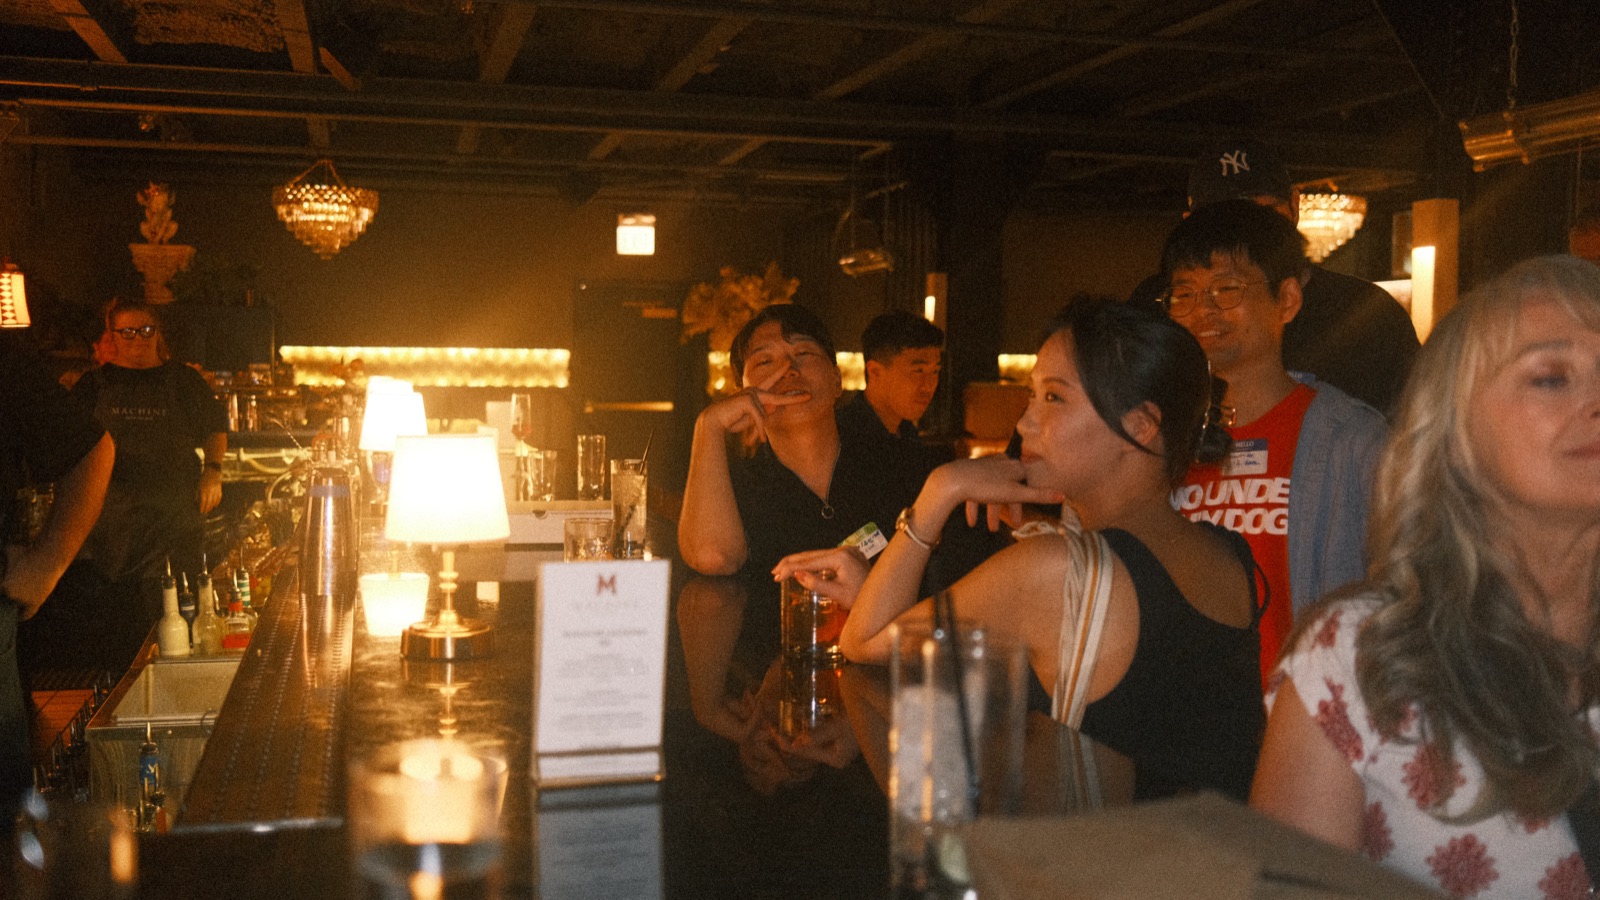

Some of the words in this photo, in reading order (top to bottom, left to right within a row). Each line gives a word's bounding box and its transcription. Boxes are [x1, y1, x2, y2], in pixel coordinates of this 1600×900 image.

[1220, 150, 1250, 177] NY
[1235, 440, 1255, 448] HELLO
[596, 574, 617, 596] M
